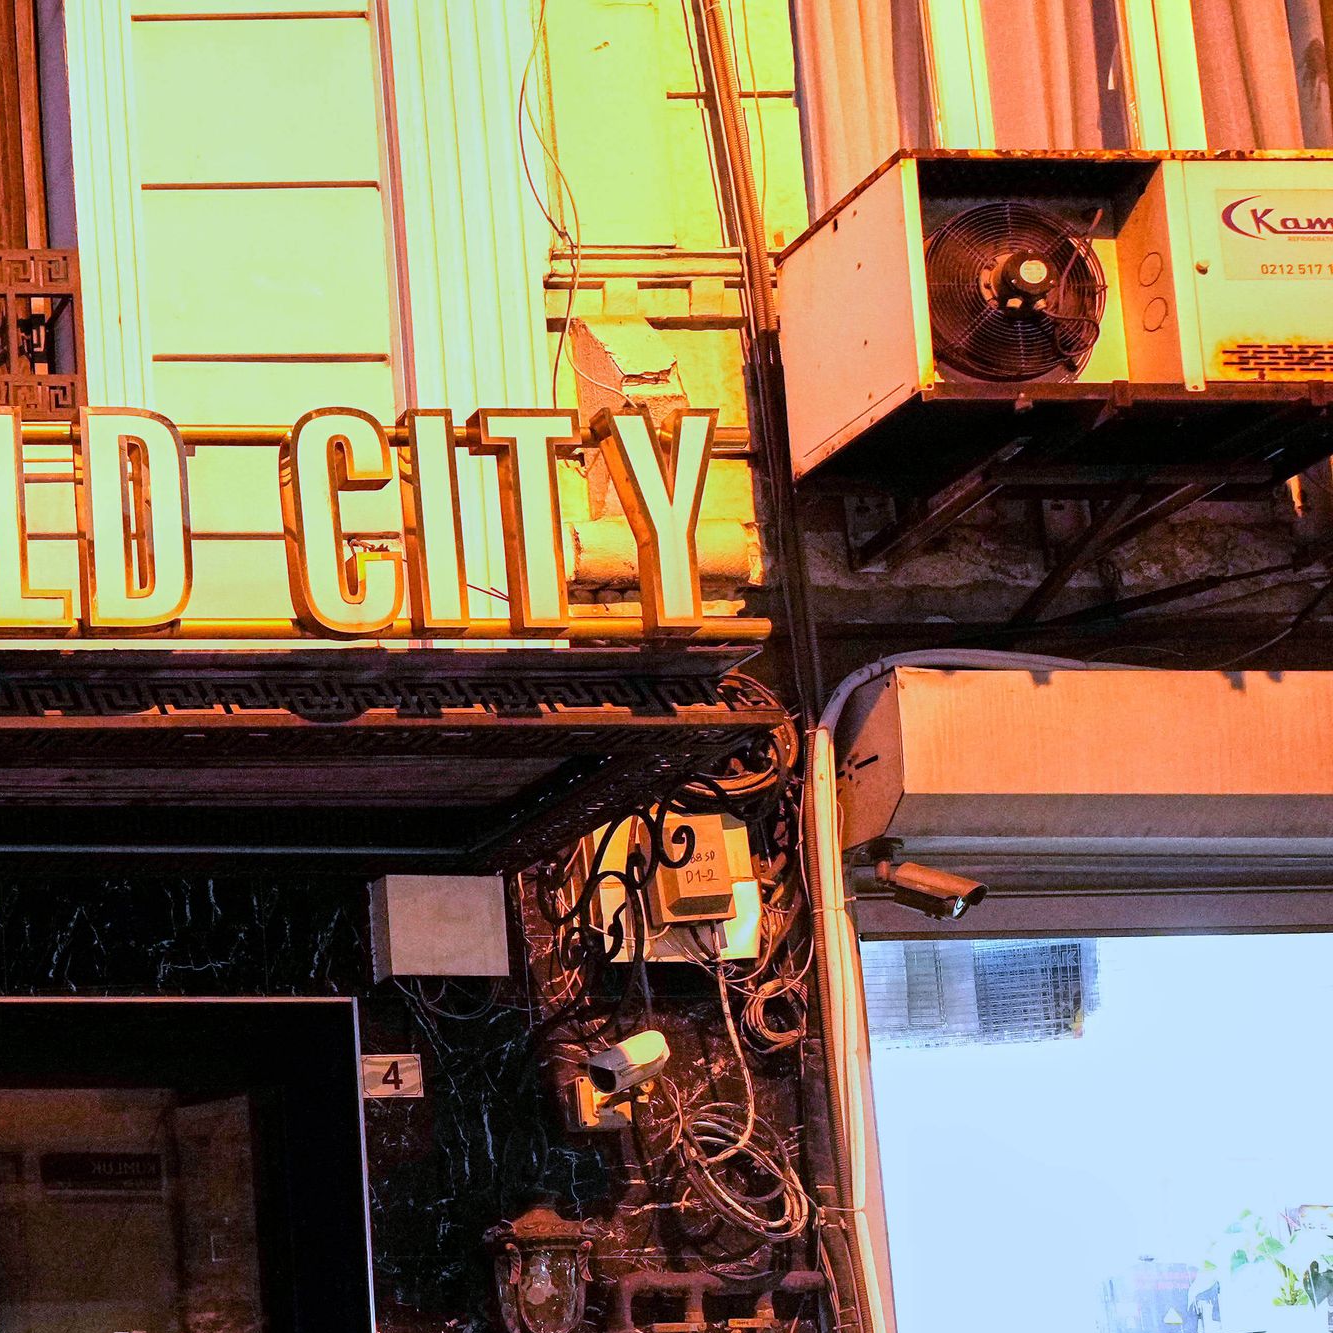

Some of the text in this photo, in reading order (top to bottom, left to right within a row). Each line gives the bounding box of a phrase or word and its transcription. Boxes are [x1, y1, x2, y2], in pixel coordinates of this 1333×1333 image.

[1261, 264, 1294, 275] 0212
[1298, 264, 1322, 275] 517
[281, 405, 720, 636] CITY
[382, 1061, 403, 1090] 4
